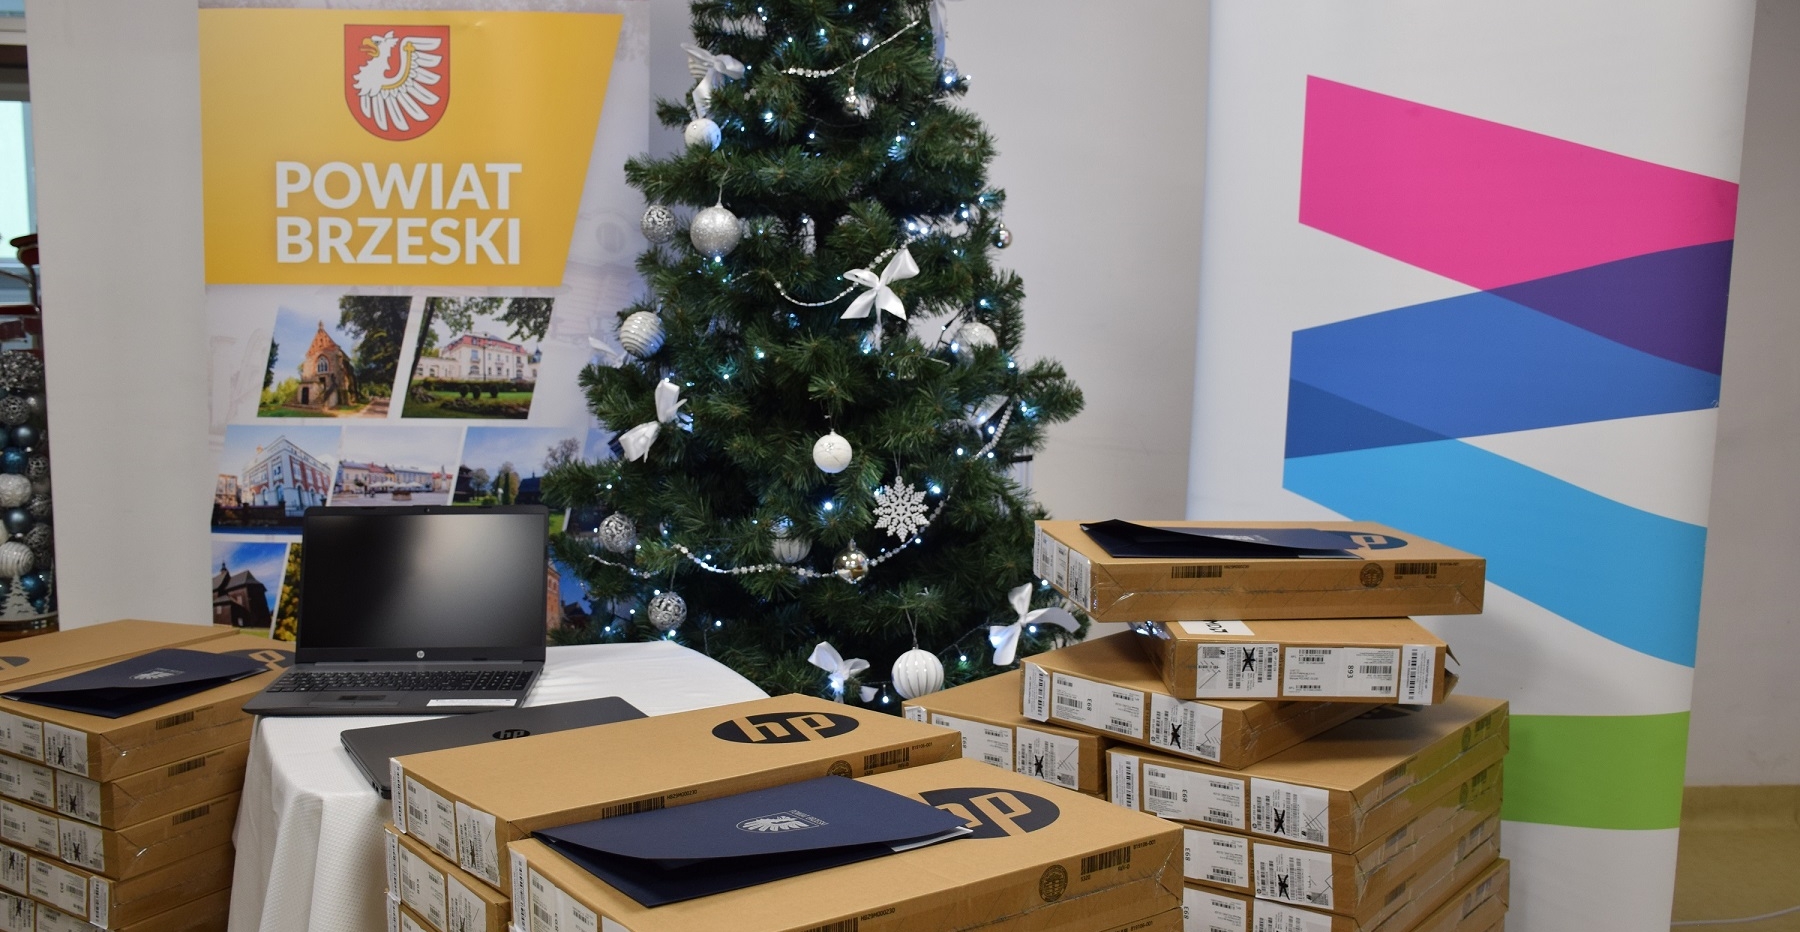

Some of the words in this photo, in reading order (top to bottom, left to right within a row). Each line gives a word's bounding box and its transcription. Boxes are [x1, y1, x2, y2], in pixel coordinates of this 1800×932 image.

[275, 160, 523, 211] POWIAT
[276, 216, 521, 266] BRZESKI
[1346, 664, 1355, 680] 893
[1086, 698, 1094, 712] 893
[731, 713, 837, 744] hp
